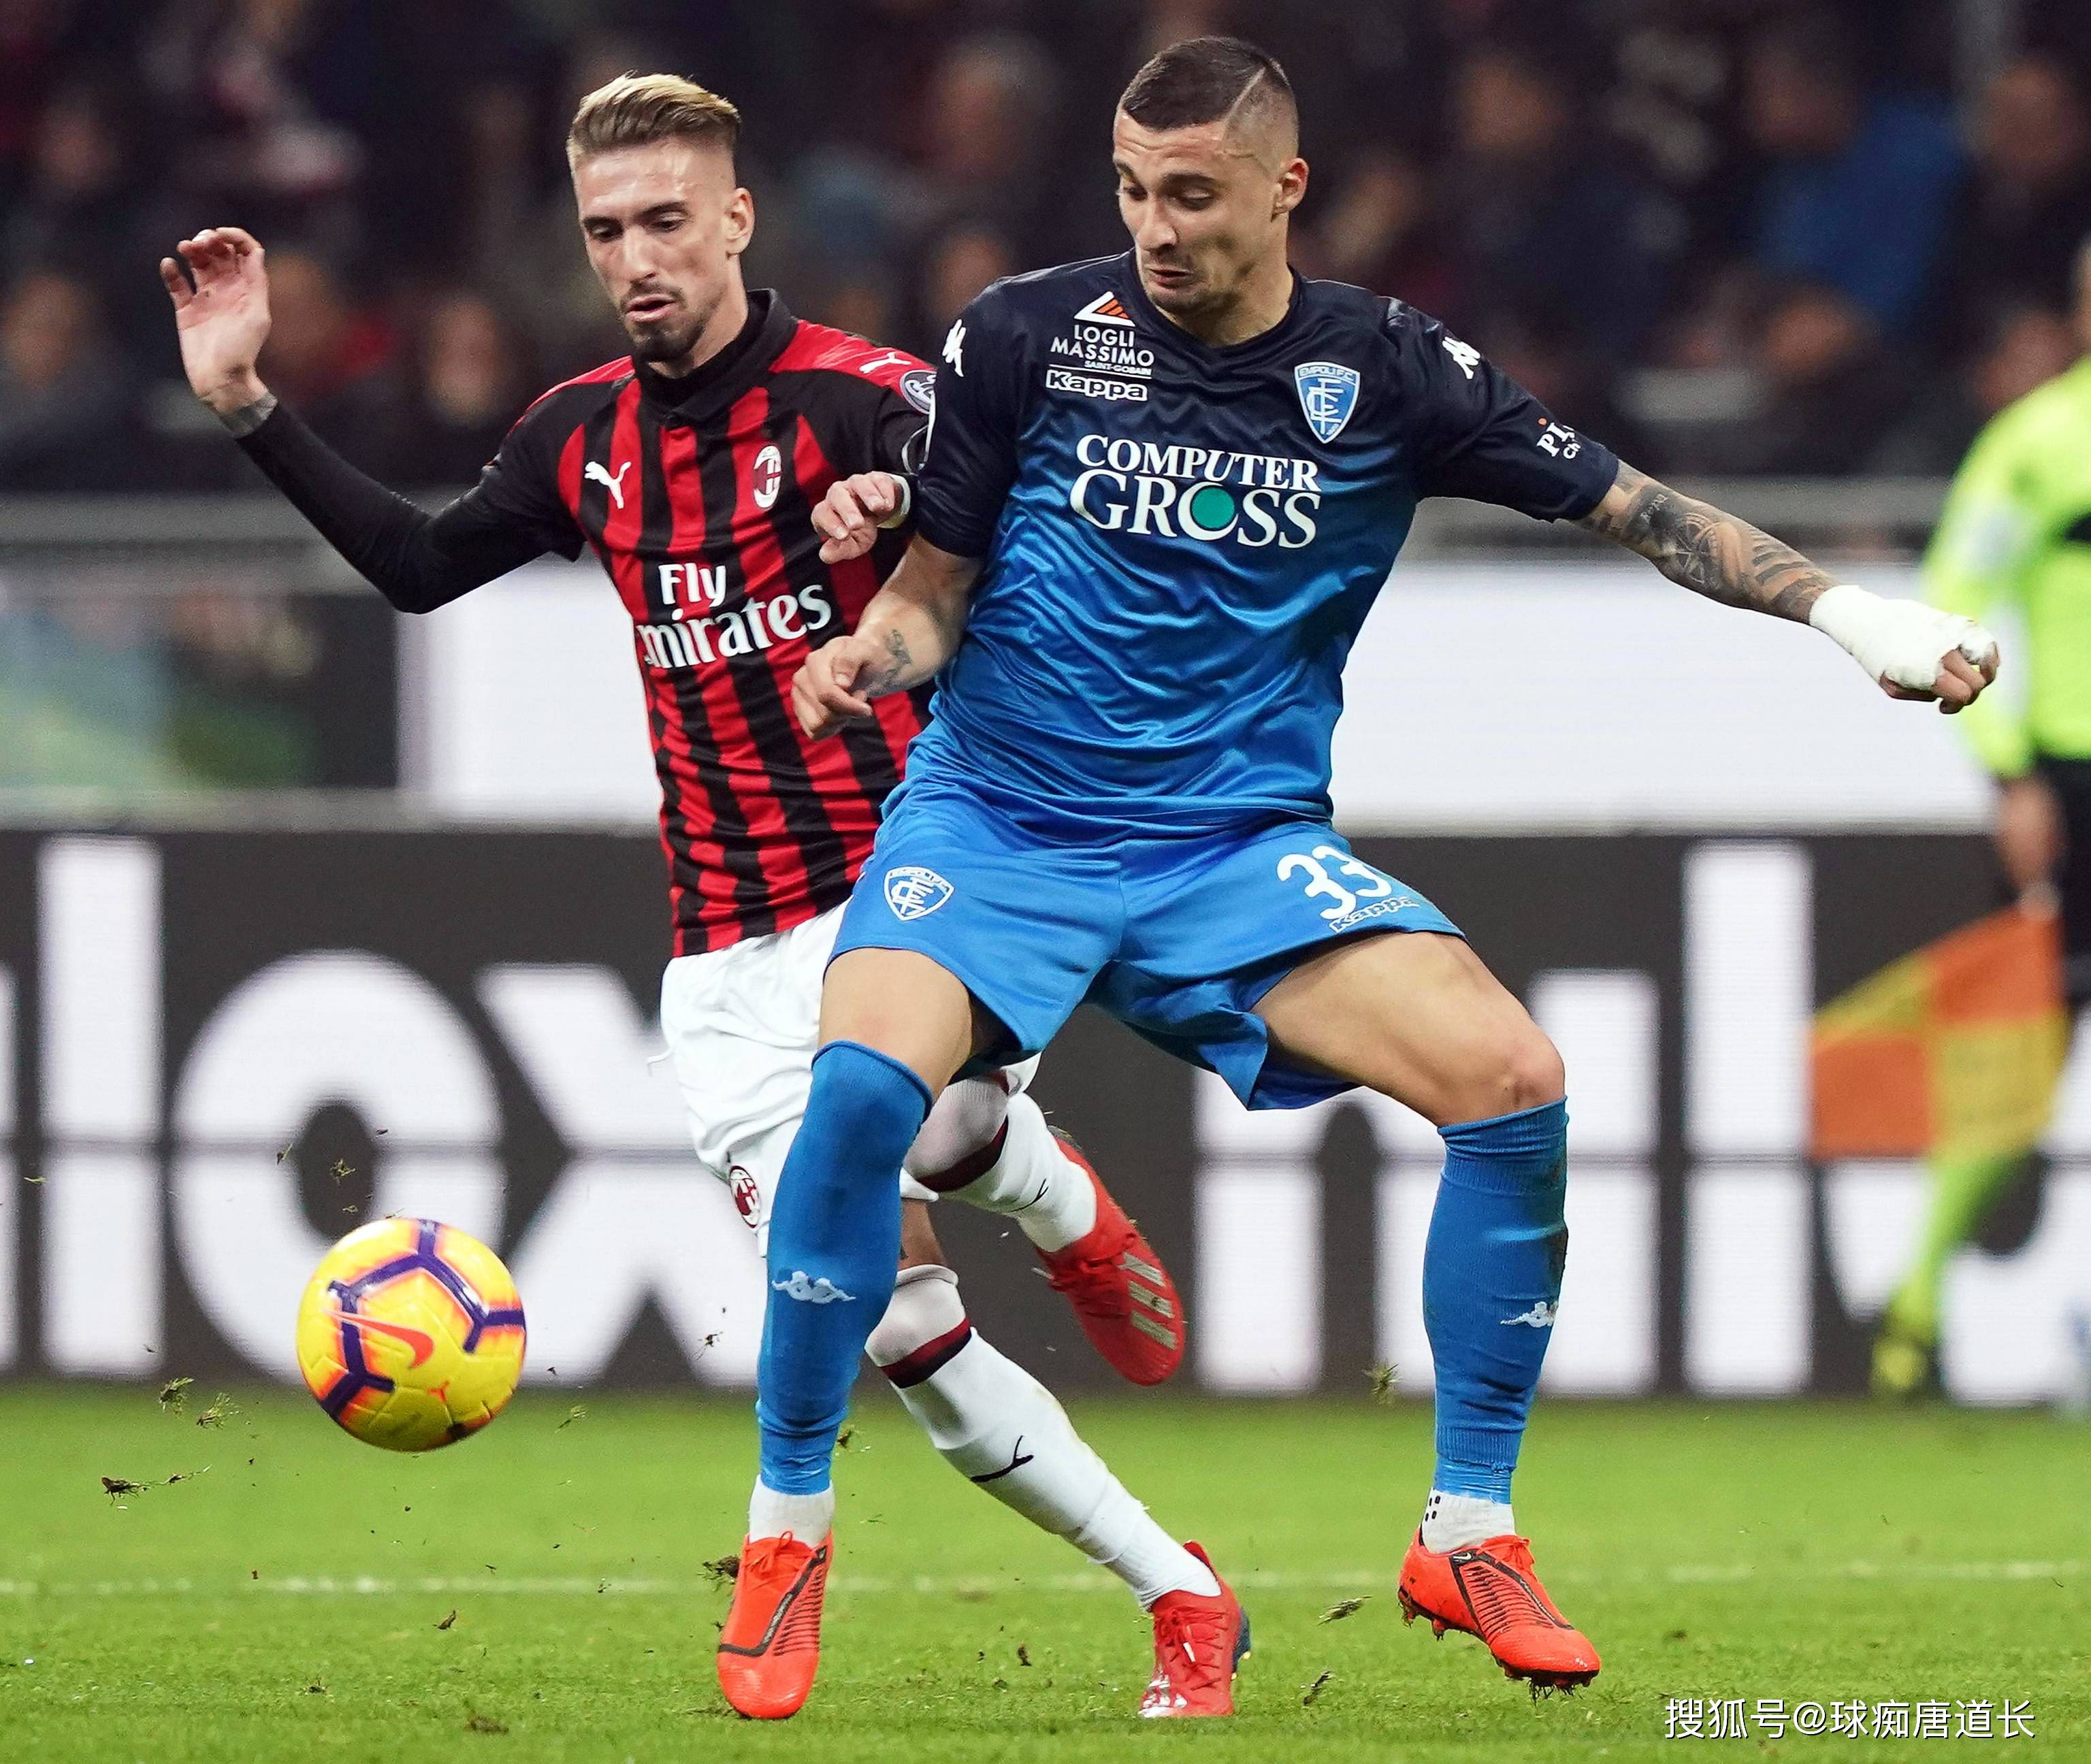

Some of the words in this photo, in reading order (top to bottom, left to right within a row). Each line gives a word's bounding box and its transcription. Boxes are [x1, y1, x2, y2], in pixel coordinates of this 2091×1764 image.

[1050, 336, 1155, 367] MASSIMO
[1073, 324, 1135, 348] LOGLI
[1046, 369, 1148, 402] Kappa
[1075, 434, 1321, 493] COMPUTER
[1069, 468, 1322, 549] GROSS
[658, 562, 726, 608] Fly
[636, 584, 832, 669] mirates
[1277, 845, 1393, 920] 33
[1328, 895, 1420, 934] Kappa
[0, 836, 762, 1385] lox
